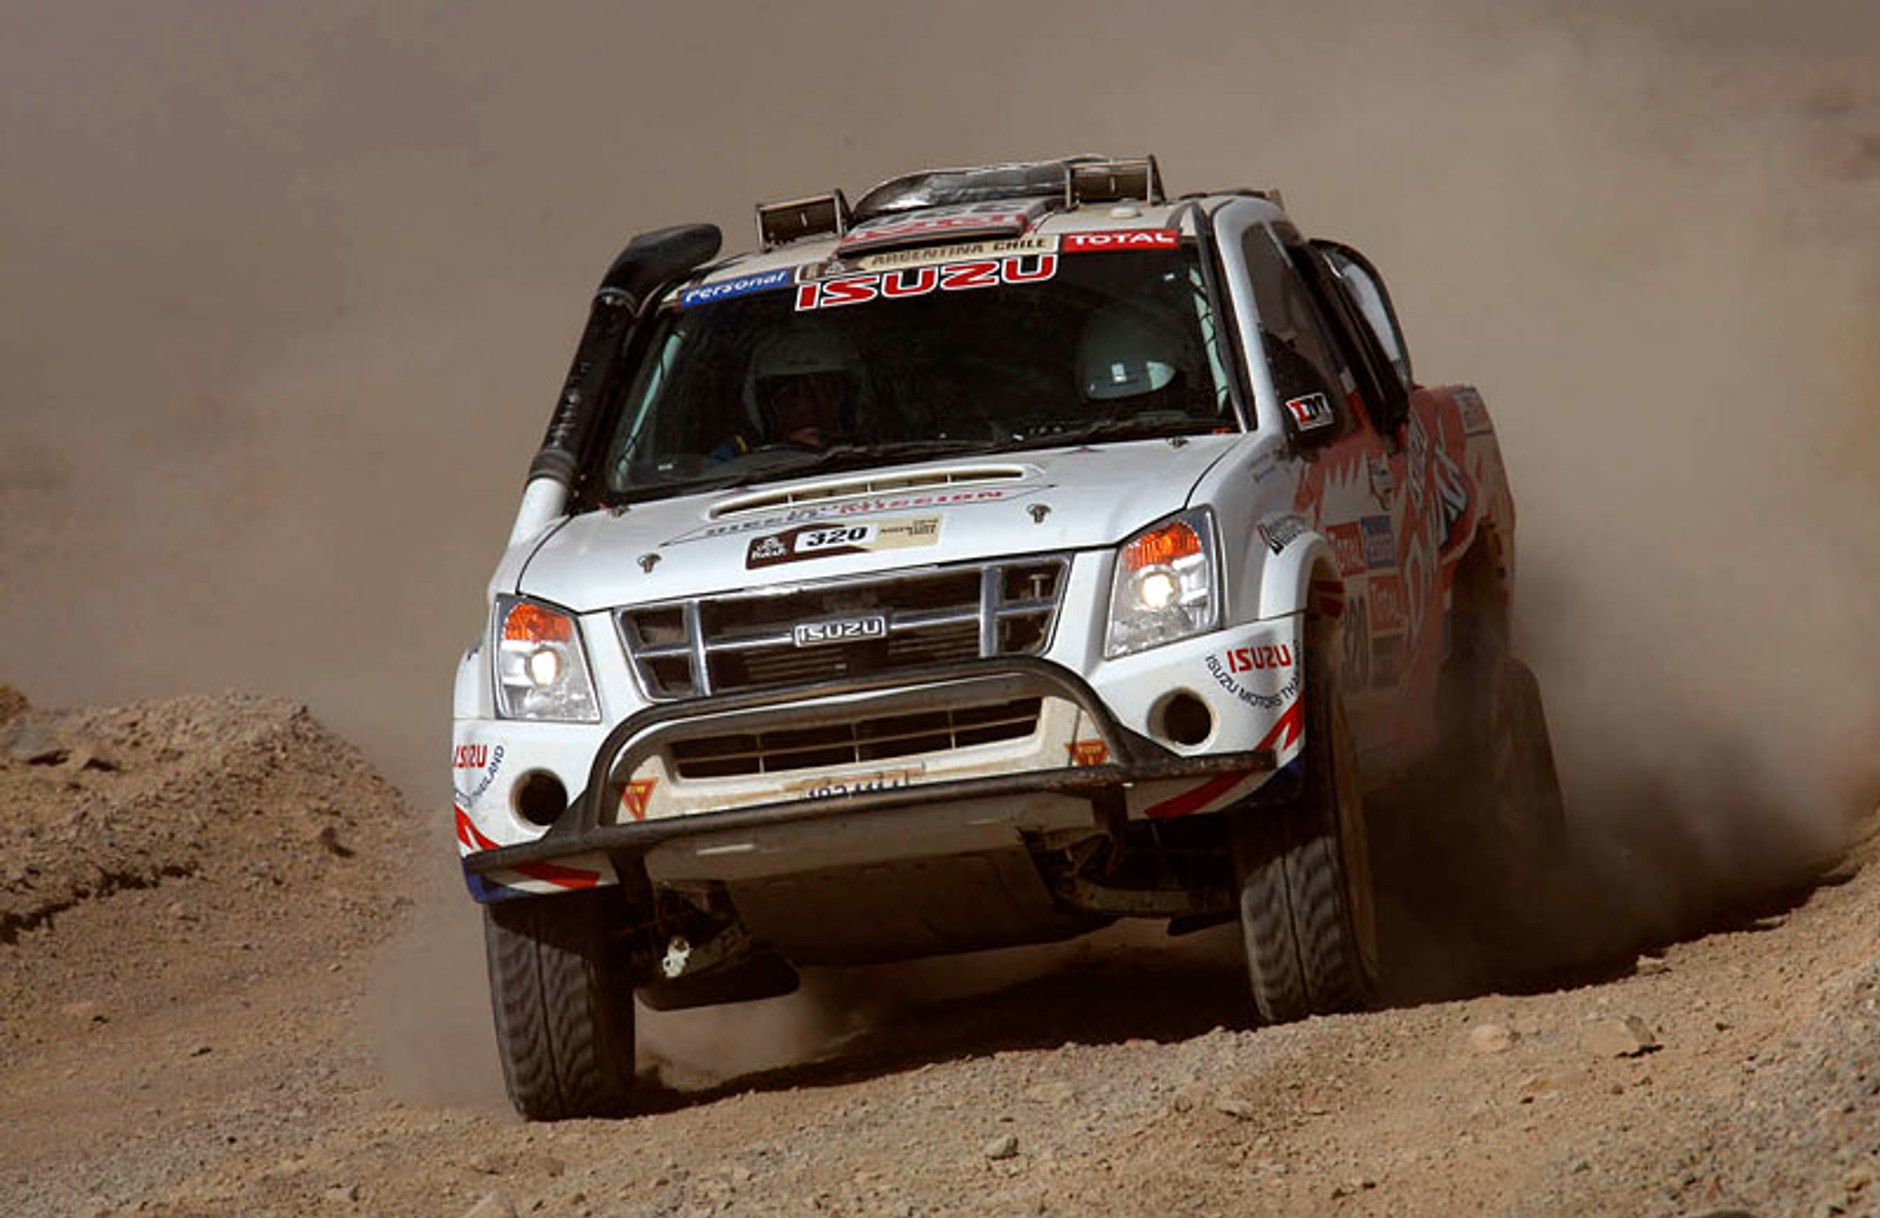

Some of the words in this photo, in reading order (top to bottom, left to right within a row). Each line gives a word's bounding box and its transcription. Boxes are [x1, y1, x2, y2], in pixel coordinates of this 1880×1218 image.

[871, 241, 984, 266] ARGENTINA
[993, 237, 1046, 251] CHILE
[1068, 232, 1174, 245] TOTAL
[684, 270, 787, 303] Personal
[795, 253, 1057, 312] ISUZU
[806, 526, 868, 548] 320
[799, 618, 883, 644] ISUZU
[1205, 653, 1240, 694] ISUZU
[1226, 643, 1293, 675] ISUZU
